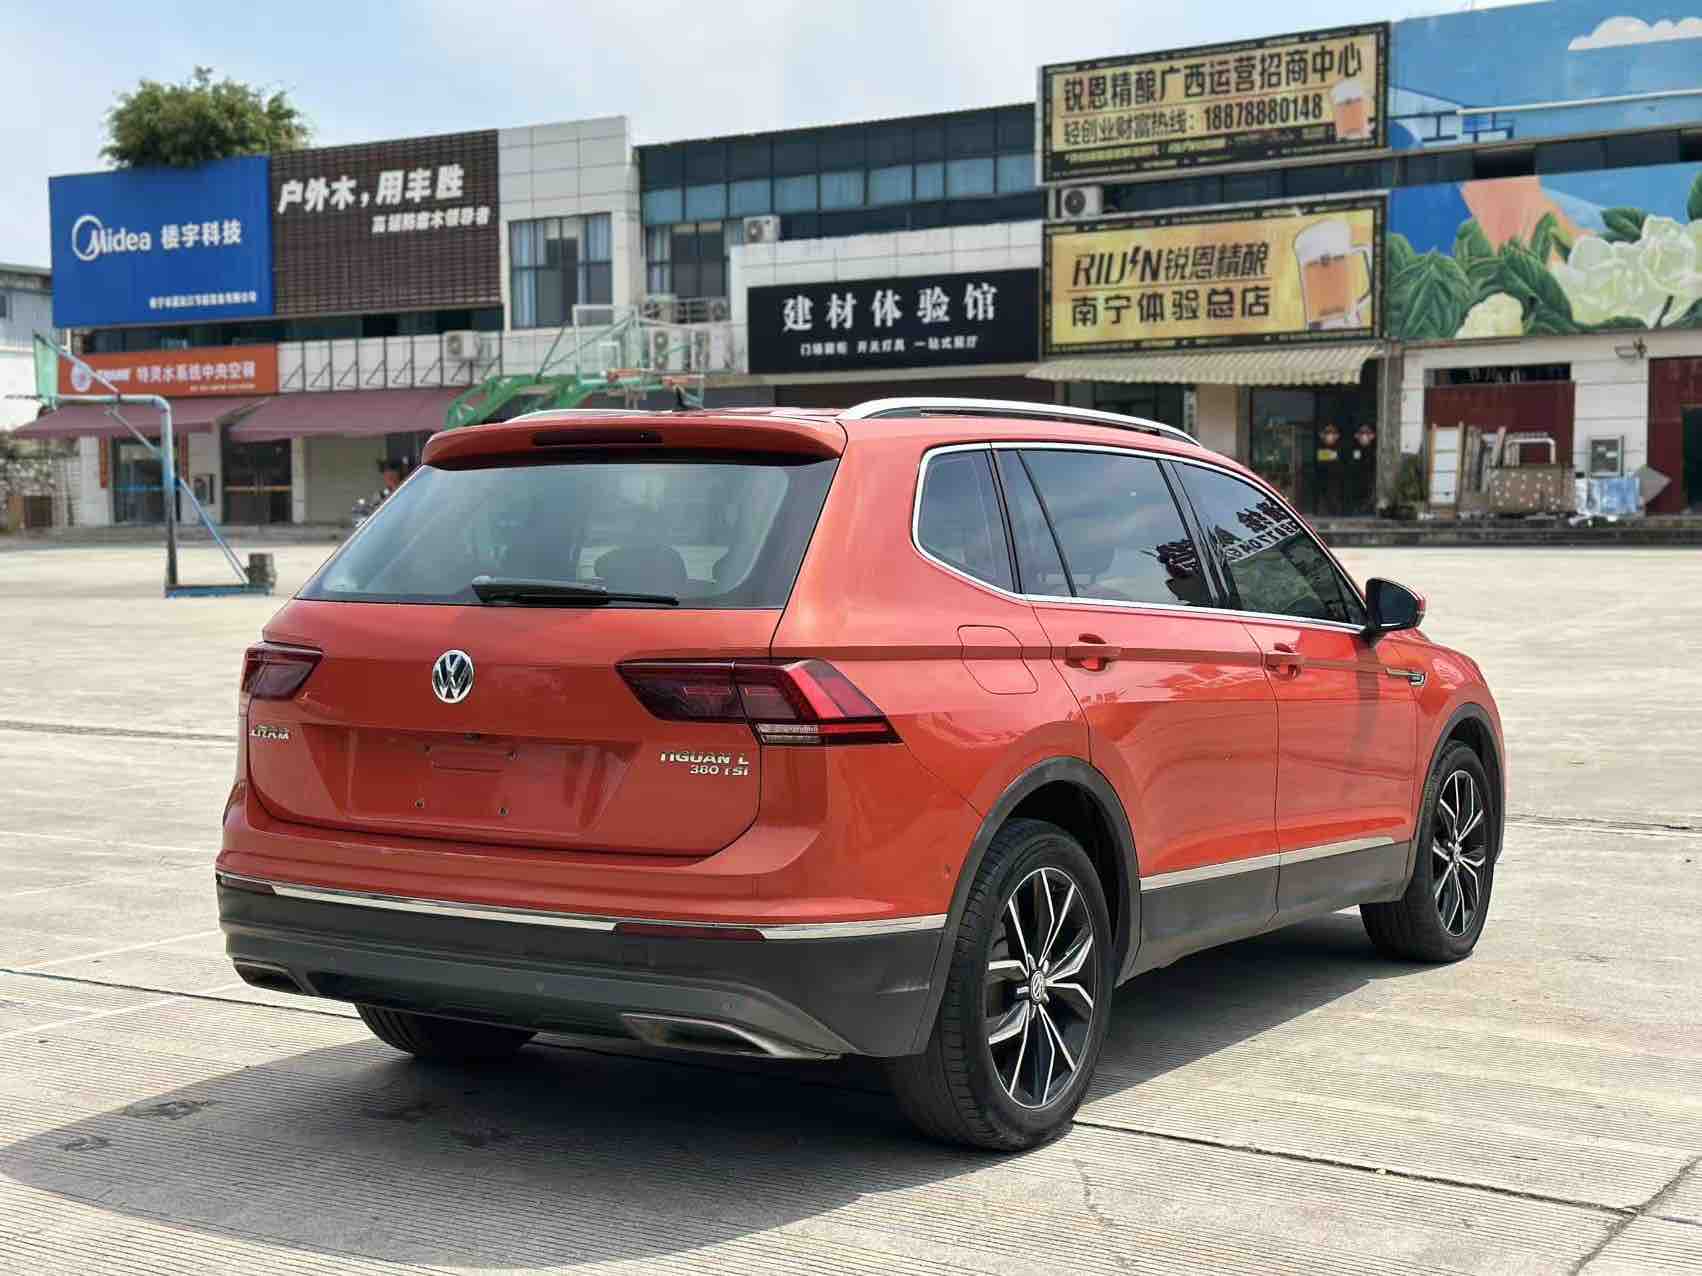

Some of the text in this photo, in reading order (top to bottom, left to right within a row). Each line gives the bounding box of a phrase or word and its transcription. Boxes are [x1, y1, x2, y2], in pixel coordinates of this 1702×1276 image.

[1203, 93, 1323, 132] 18878880148
[71, 214, 152, 261] Midea
[783, 282, 997, 332] 建材体验馆
[1071, 286, 1271, 327] 南宁体验总店
[689, 763, 720, 775] 380
